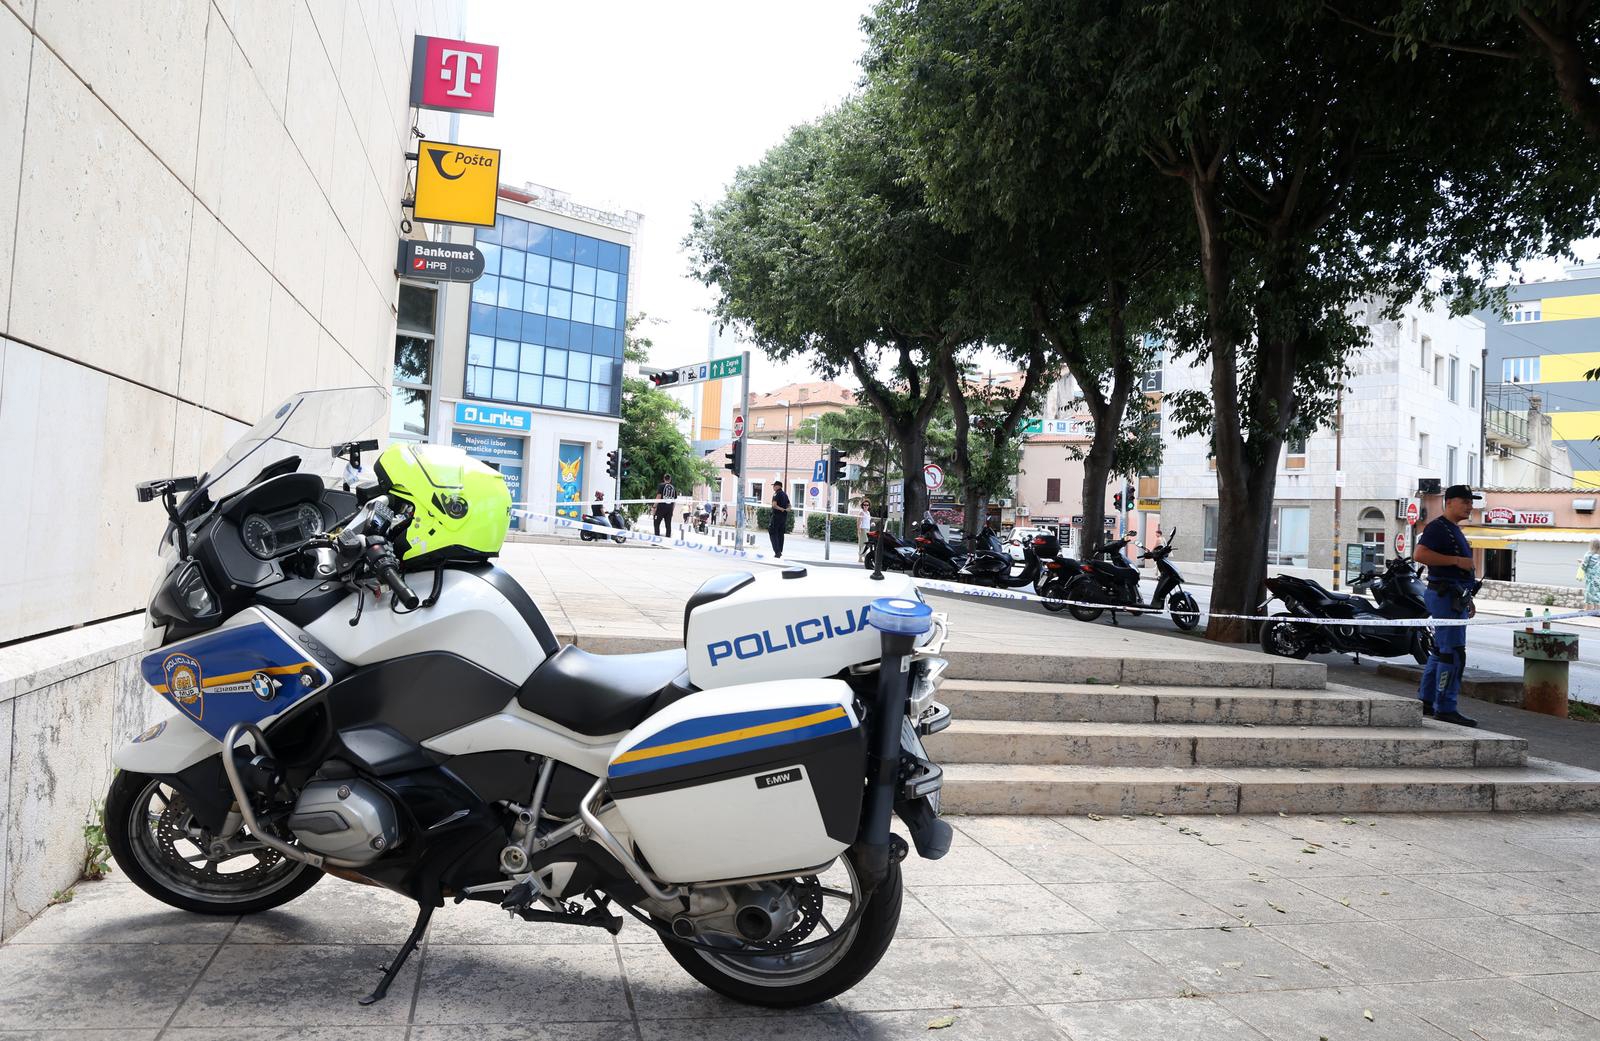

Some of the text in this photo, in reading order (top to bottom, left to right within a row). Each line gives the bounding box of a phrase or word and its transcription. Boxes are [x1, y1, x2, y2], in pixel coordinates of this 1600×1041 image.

[440, 48, 483, 98] T
[454, 151, 493, 168] Pošta
[414, 245, 475, 260] Bankomat
[426, 260, 447, 271] HPB
[465, 437, 507, 447] Najveći izbor
[1518, 513, 1549, 525] Niko
[166, 657, 198, 672] POLICIJA
[179, 689, 195, 697] MUP
